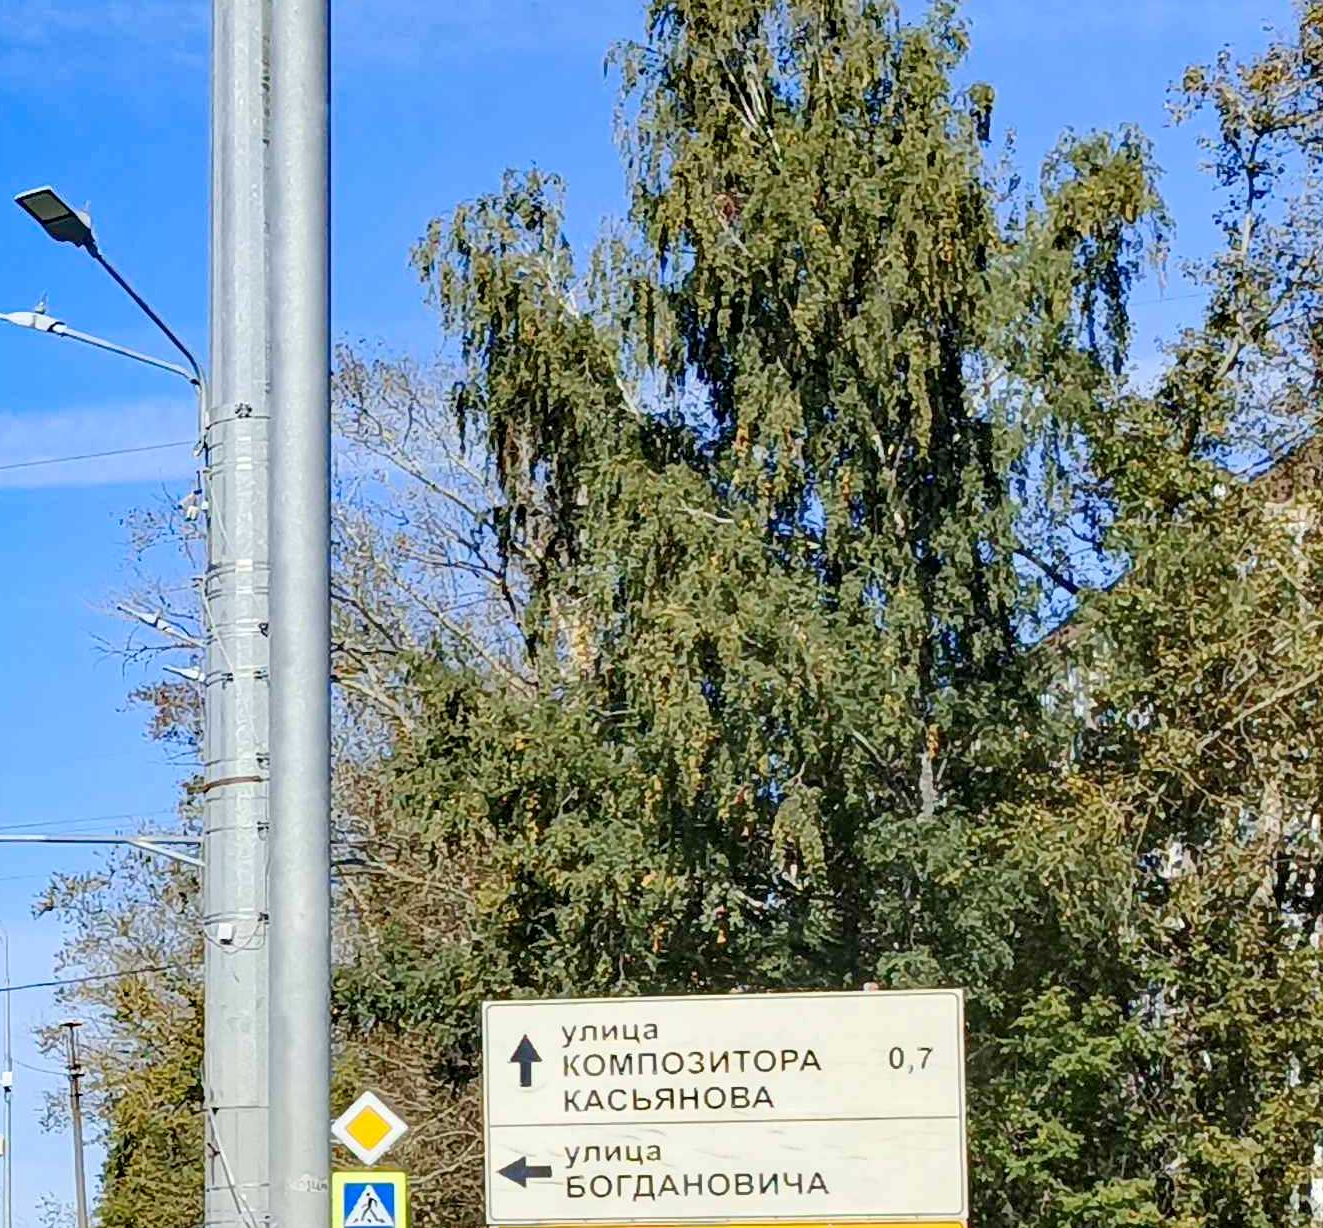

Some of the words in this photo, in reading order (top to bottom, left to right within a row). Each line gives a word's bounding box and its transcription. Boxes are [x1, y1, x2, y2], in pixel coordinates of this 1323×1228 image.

[561, 1022, 659, 1048] улица
[563, 1049, 822, 1078] КОМПОЗИТОРА
[888, 1046, 933, 1075] 0,7
[564, 1085, 774, 1112] КАСЬЯНОВА
[564, 1144, 662, 1169] улица
[566, 1171, 830, 1202] БОГДАНОВИЧА
